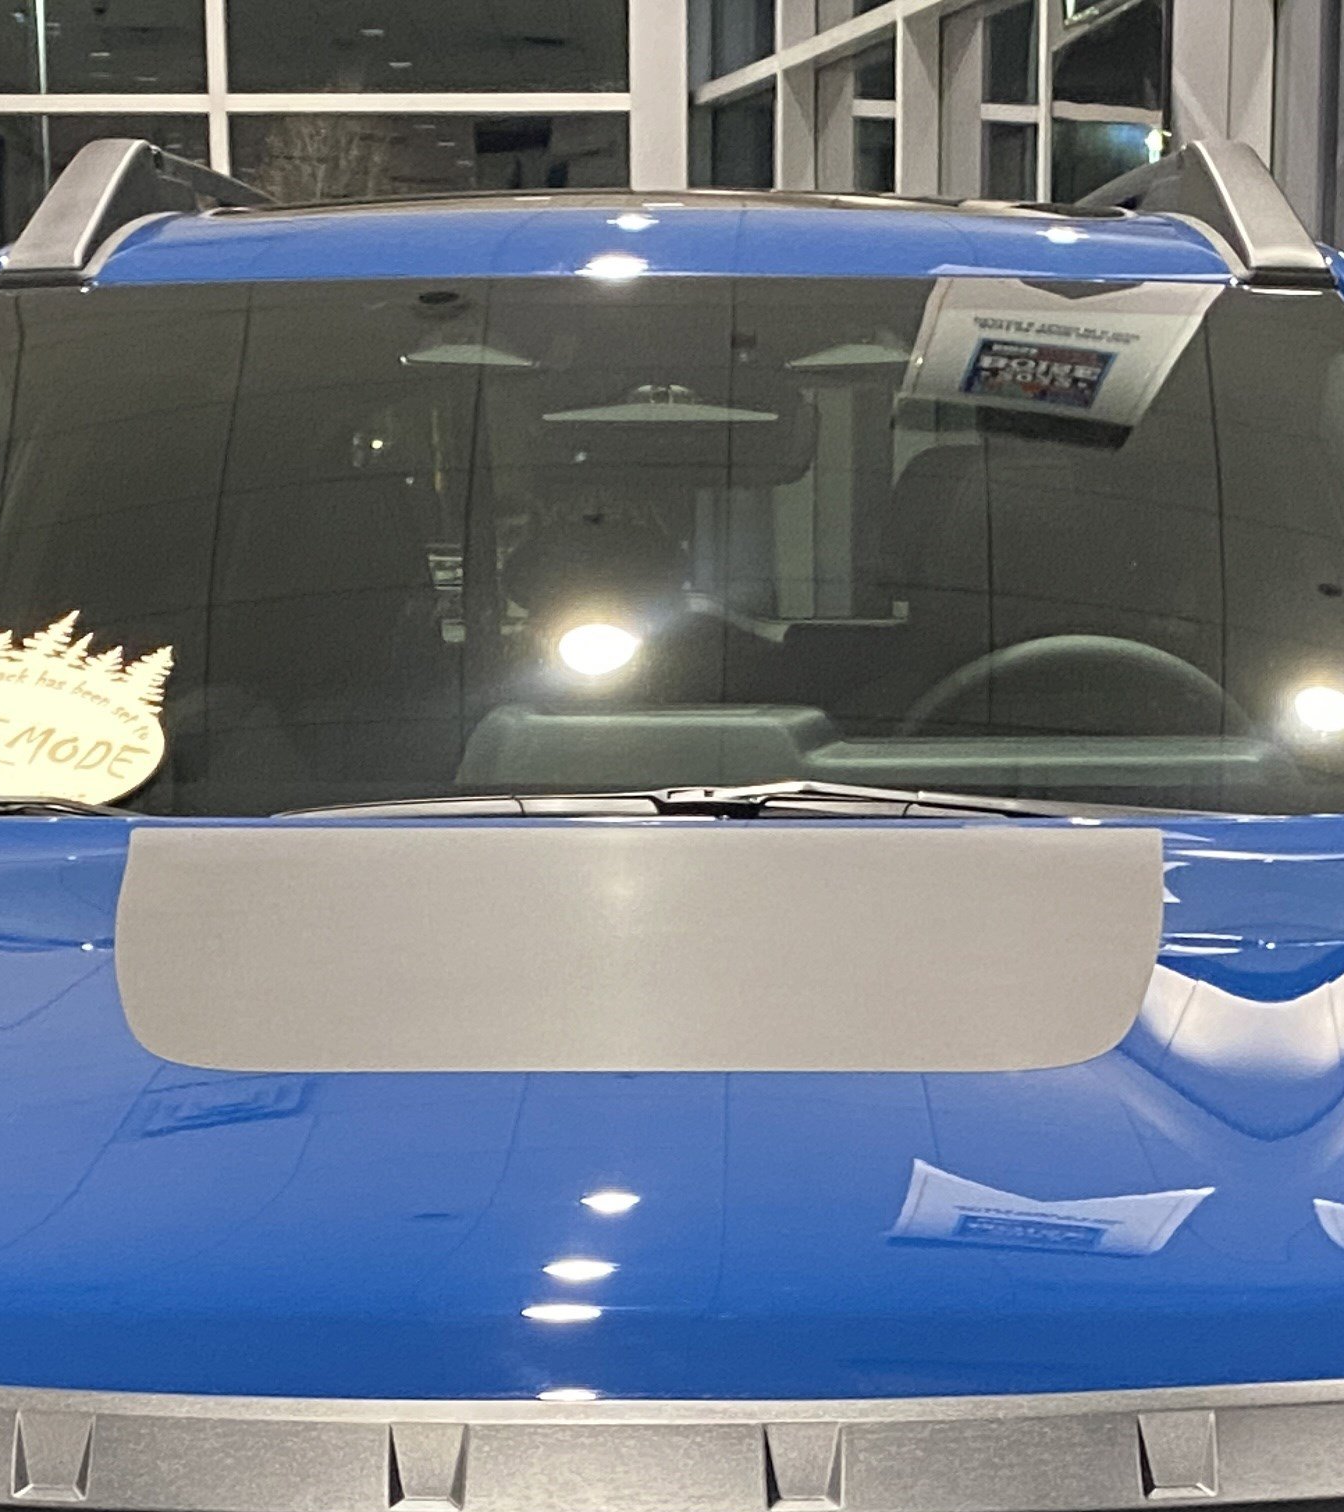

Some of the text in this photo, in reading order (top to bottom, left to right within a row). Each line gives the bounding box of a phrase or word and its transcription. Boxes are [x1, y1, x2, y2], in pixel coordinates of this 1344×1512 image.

[34, 670, 68, 690] has
[71, 680, 111, 706] been
[4, 726, 151, 780] MODE
